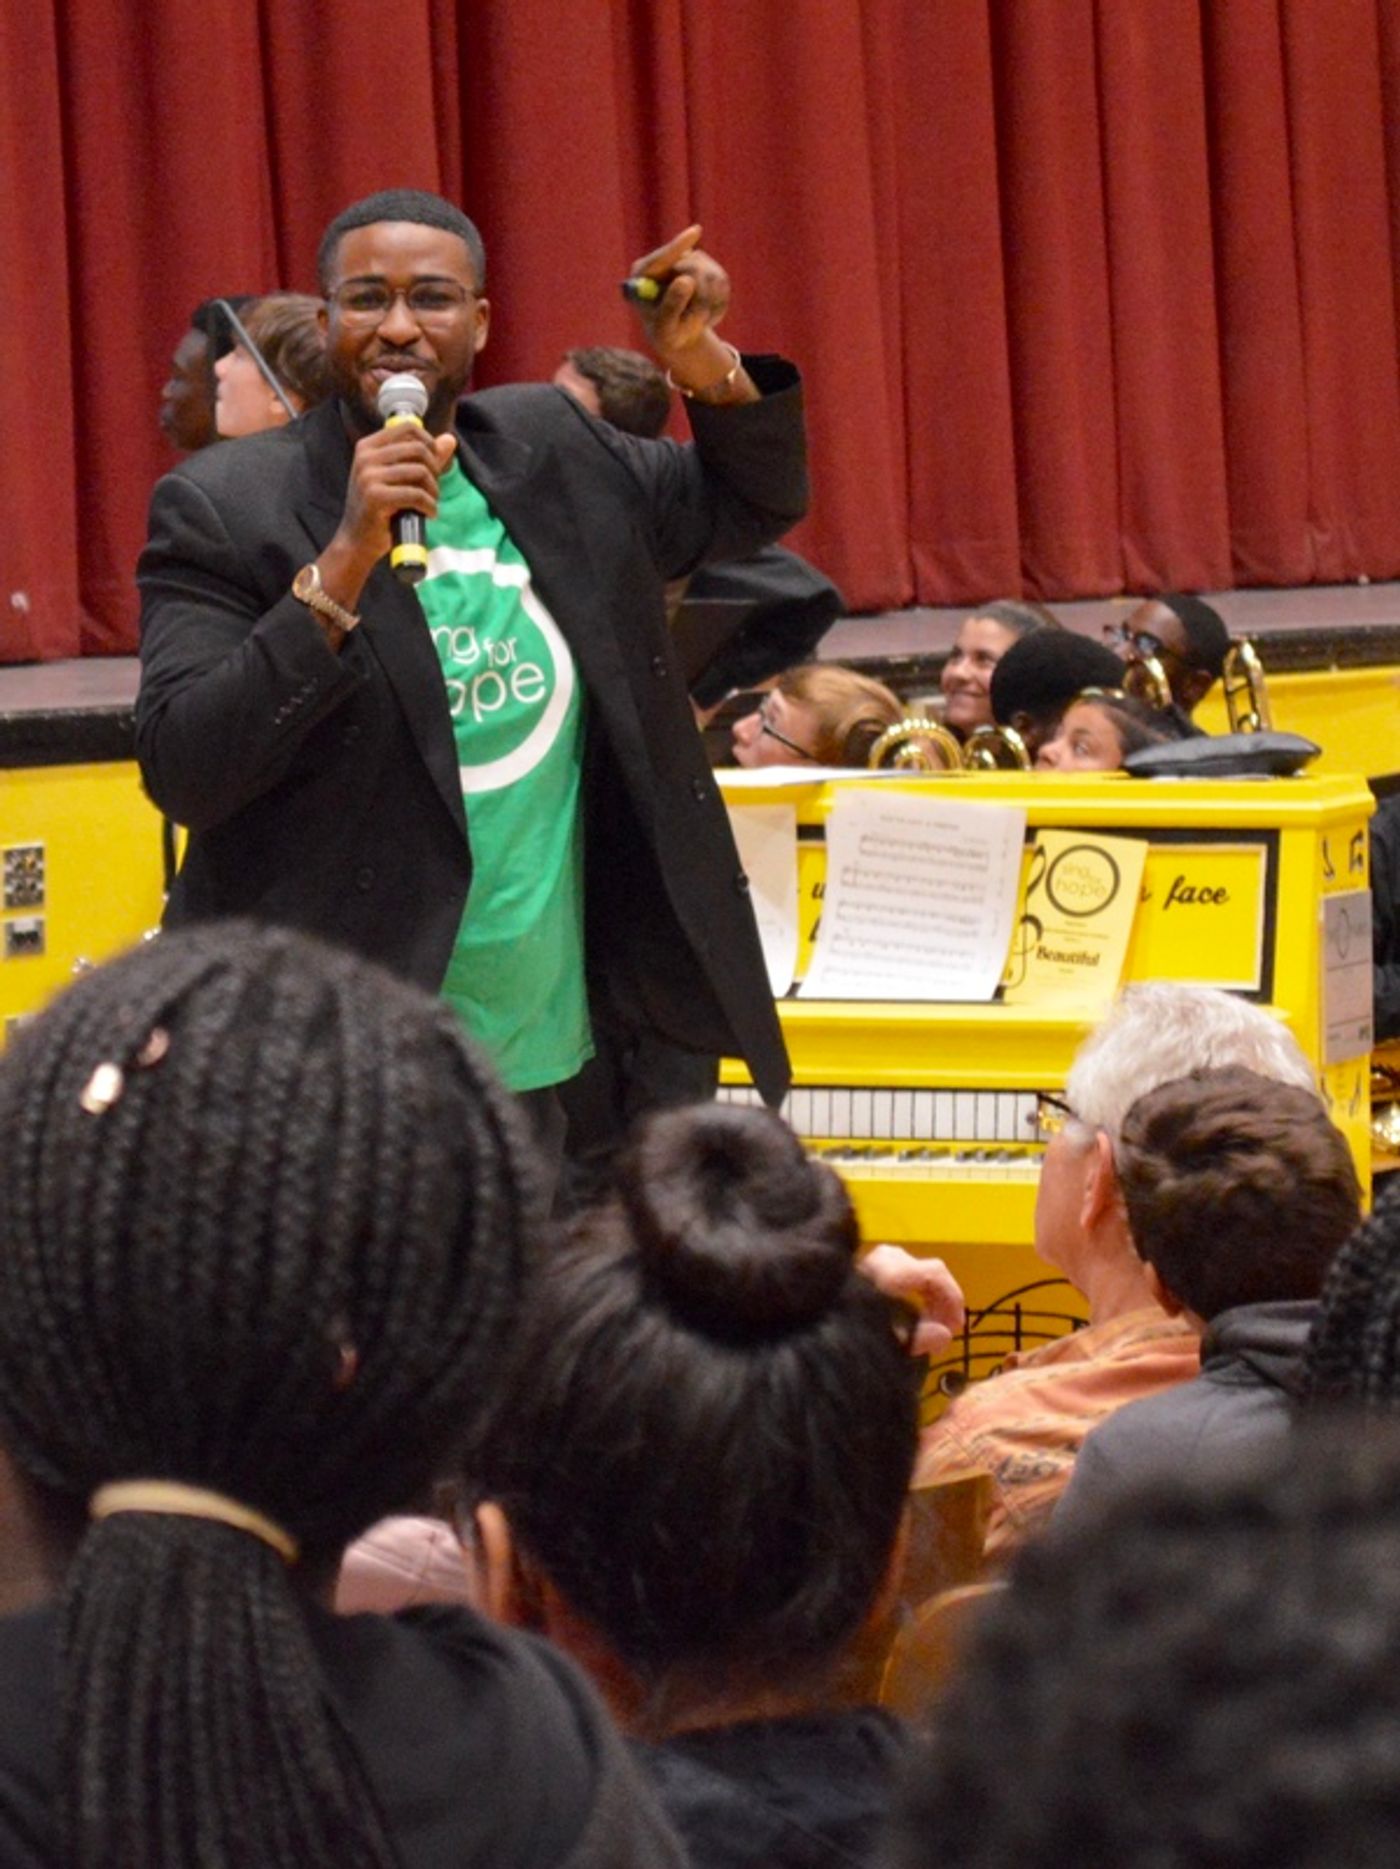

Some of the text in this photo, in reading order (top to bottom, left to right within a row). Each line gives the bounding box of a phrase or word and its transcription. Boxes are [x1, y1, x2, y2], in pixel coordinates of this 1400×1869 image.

[481, 635, 518, 666] for
[1055, 877, 1107, 899] hope
[1162, 873, 1230, 911] face
[1036, 945, 1101, 967] Beautiful
